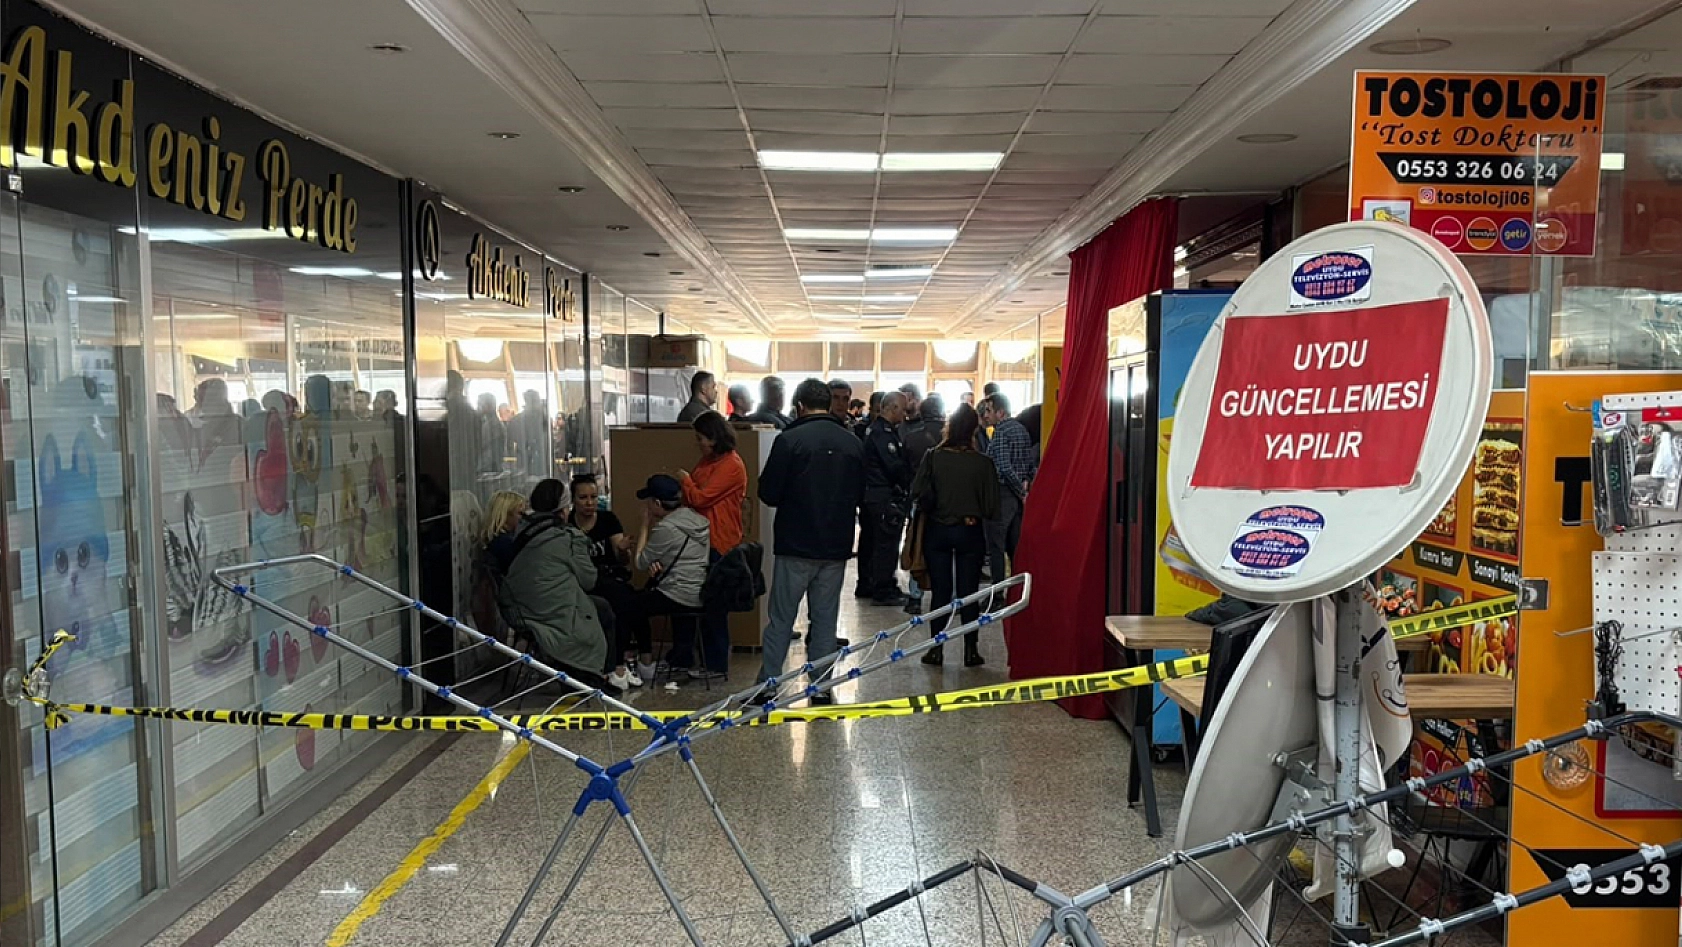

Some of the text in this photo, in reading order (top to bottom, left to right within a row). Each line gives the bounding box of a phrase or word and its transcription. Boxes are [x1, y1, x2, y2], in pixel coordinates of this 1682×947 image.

[0, 25, 358, 253] Akdeniz Perde
[1396, 159, 1558, 180] 0553 326 06 24
[1436, 188, 1531, 207] tostoloji06
[1504, 229, 1527, 240] getir
[466, 232, 577, 323] Akdeniz Perde
[1293, 339, 1369, 371] UYDU
[1220, 373, 1430, 417] GÜNCELLEMESİ
[1264, 430, 1364, 461] YAPILIR
